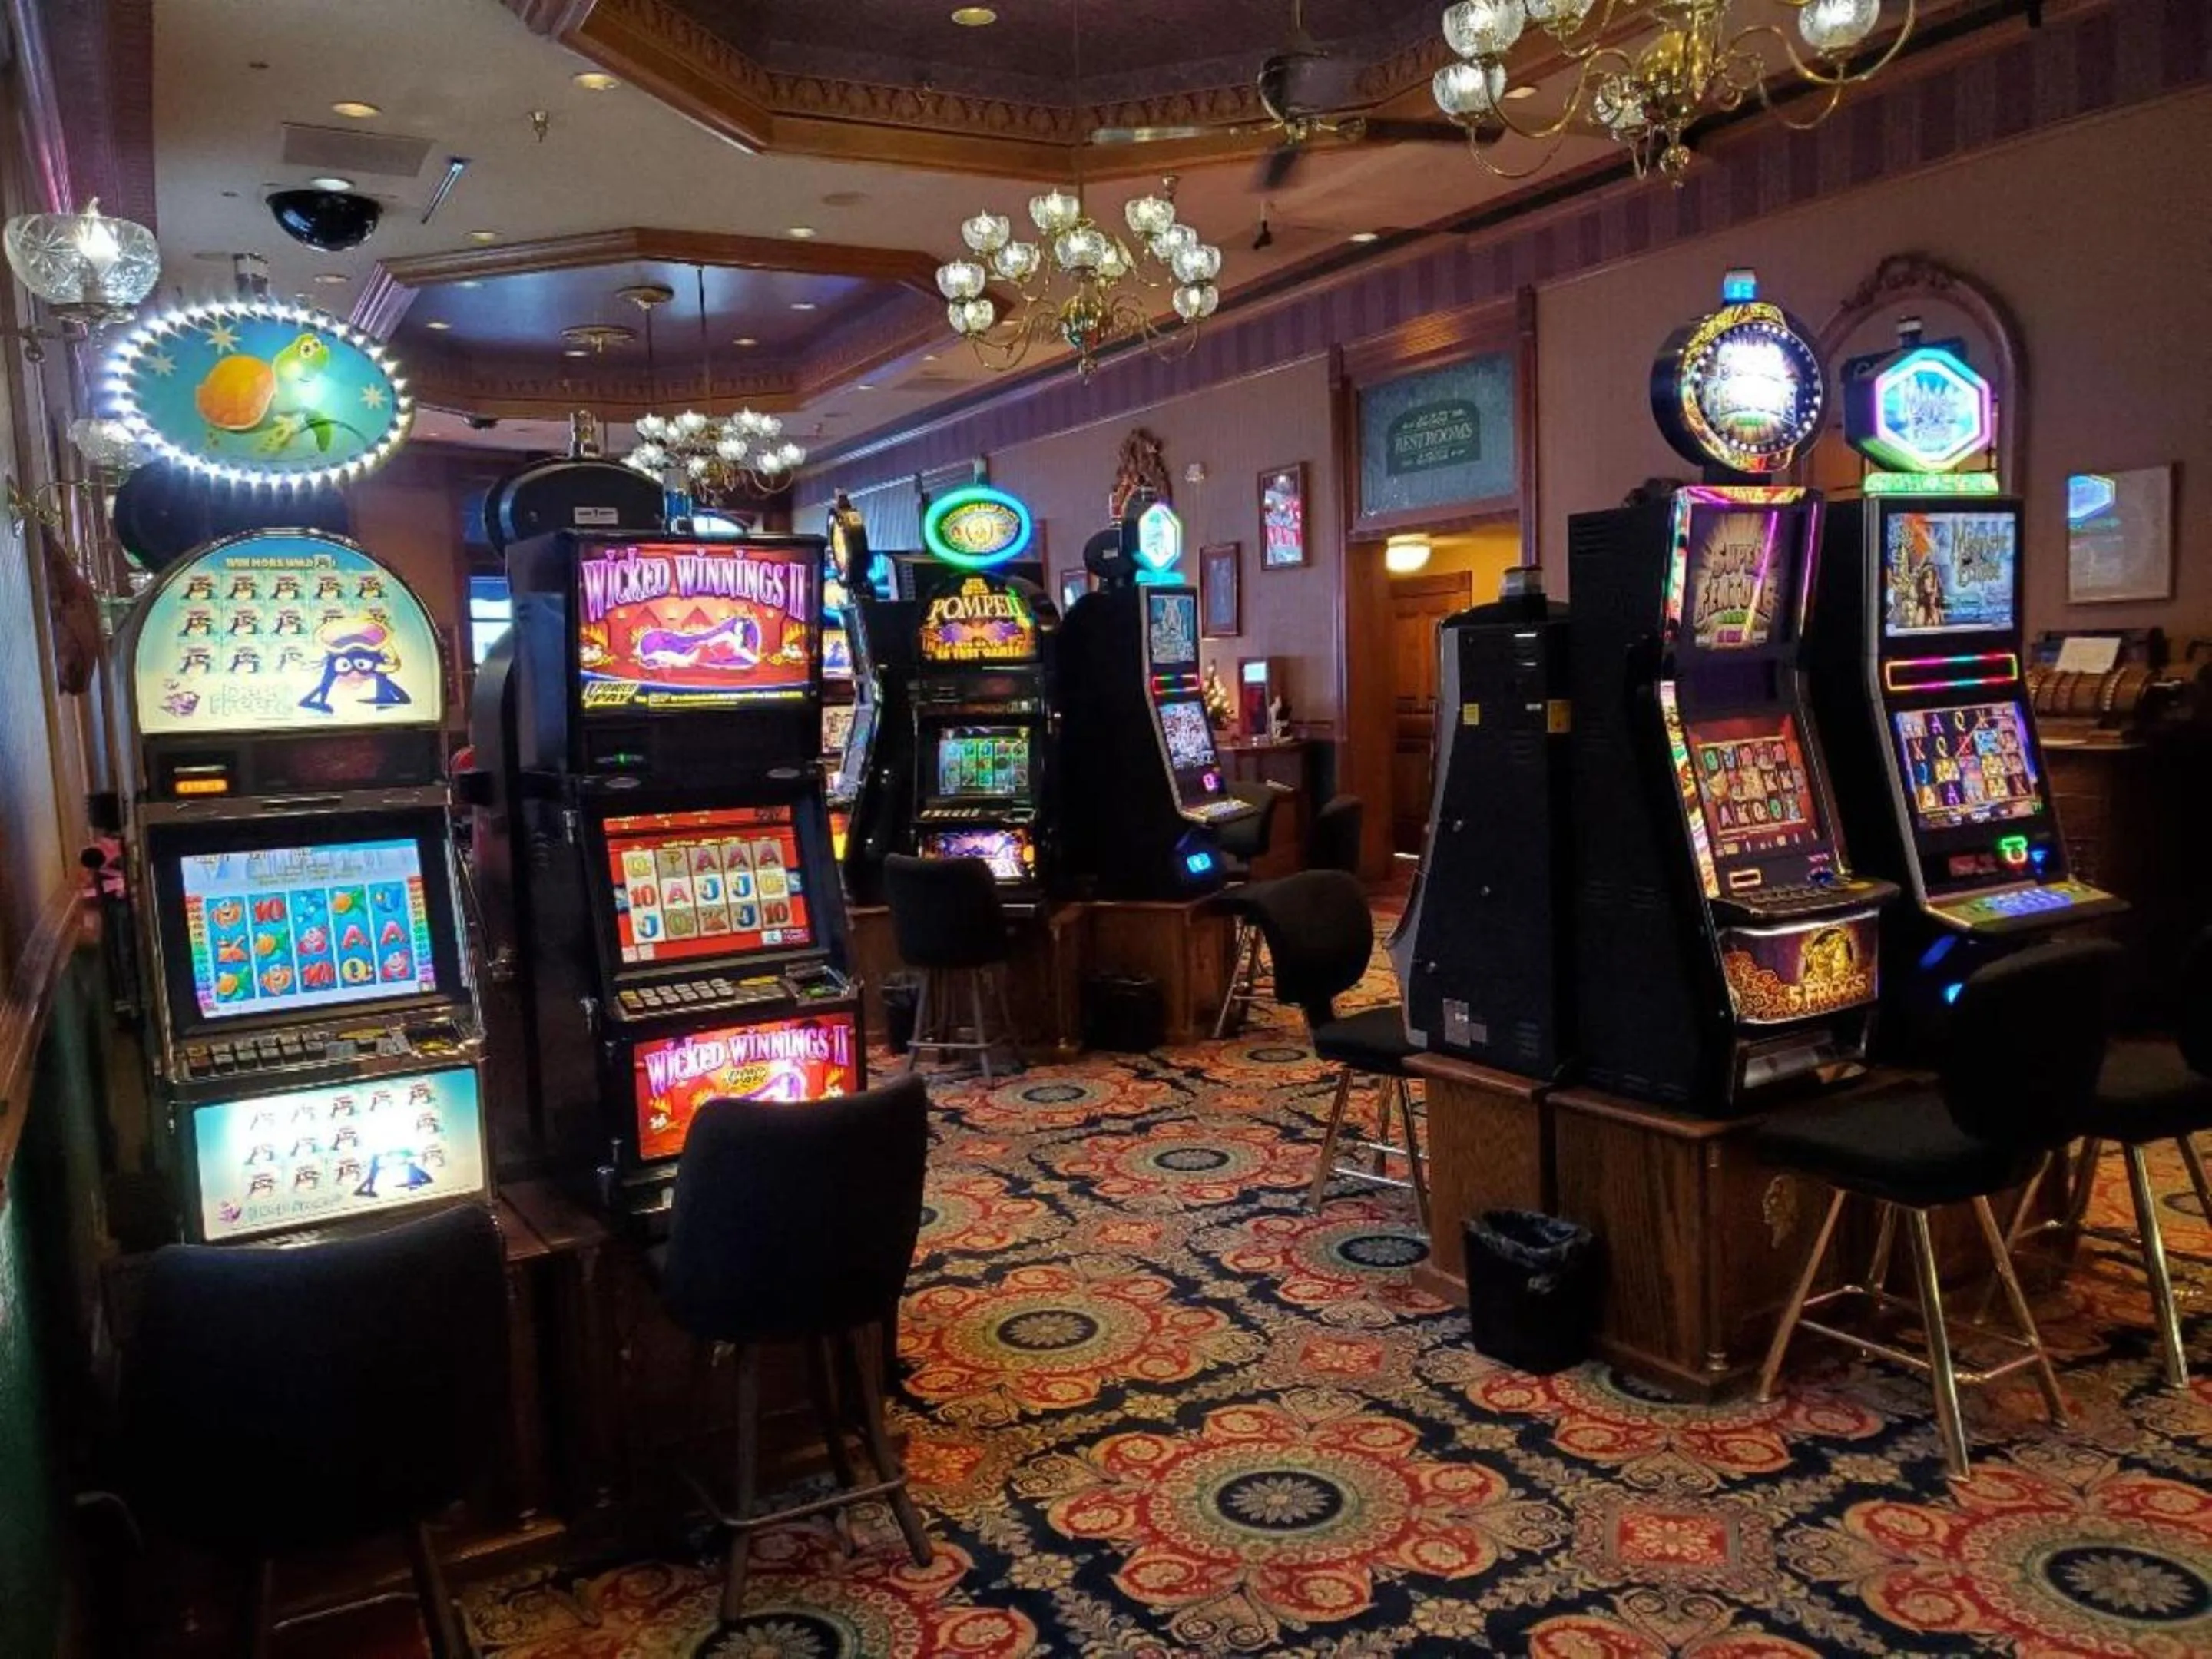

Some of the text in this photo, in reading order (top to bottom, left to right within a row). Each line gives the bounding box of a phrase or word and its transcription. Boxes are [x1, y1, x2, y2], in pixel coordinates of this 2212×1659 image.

[694, 849, 719, 873] A
[728, 846, 750, 869] A
[758, 843, 780, 866] A
[629, 884, 658, 909] 10
[667, 881, 690, 905] A
[342, 924, 370, 950] A
[381, 919, 407, 946] A
[1790, 972, 1866, 1009] 5 FROGS
